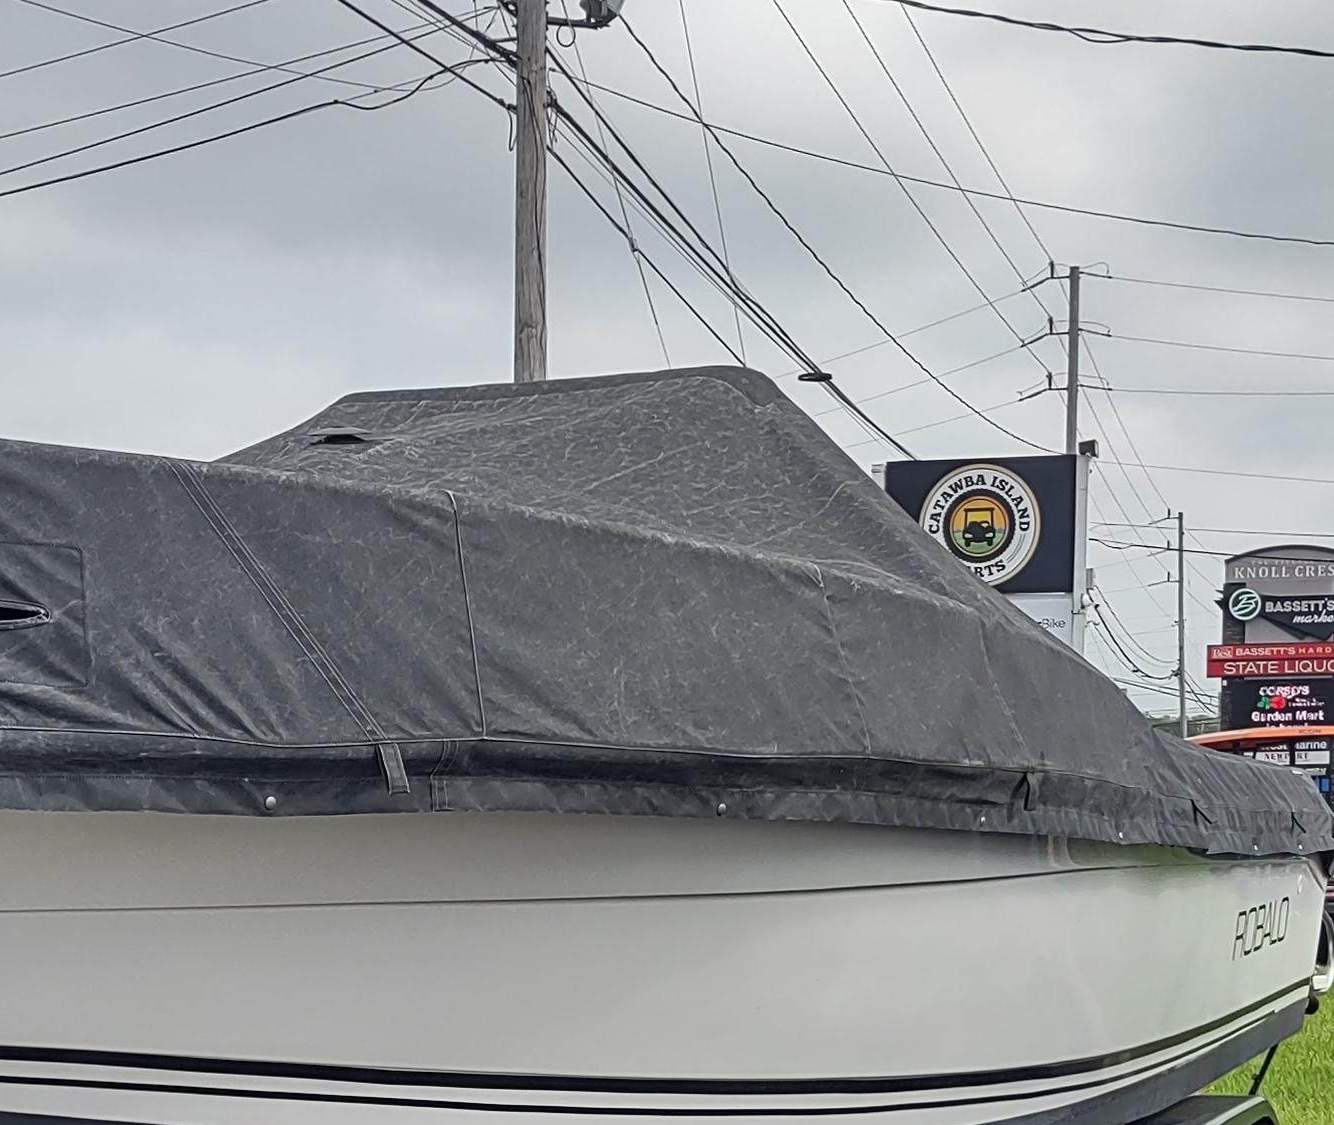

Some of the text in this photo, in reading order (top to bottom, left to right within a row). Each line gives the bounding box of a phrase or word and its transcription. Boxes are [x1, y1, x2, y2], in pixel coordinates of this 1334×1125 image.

[927, 474, 1030, 535] CATAWBA ISLAND
[968, 560, 1006, 578] RTS
[1234, 565, 1291, 579] KNOLL
[1235, 647, 1296, 657] BASSETT'S
[1223, 661, 1279, 675] STATE
[1251, 710, 1325, 722] Garden Mart
[1294, 741, 1327, 750] arine
[1232, 896, 1290, 961] ROBALO
